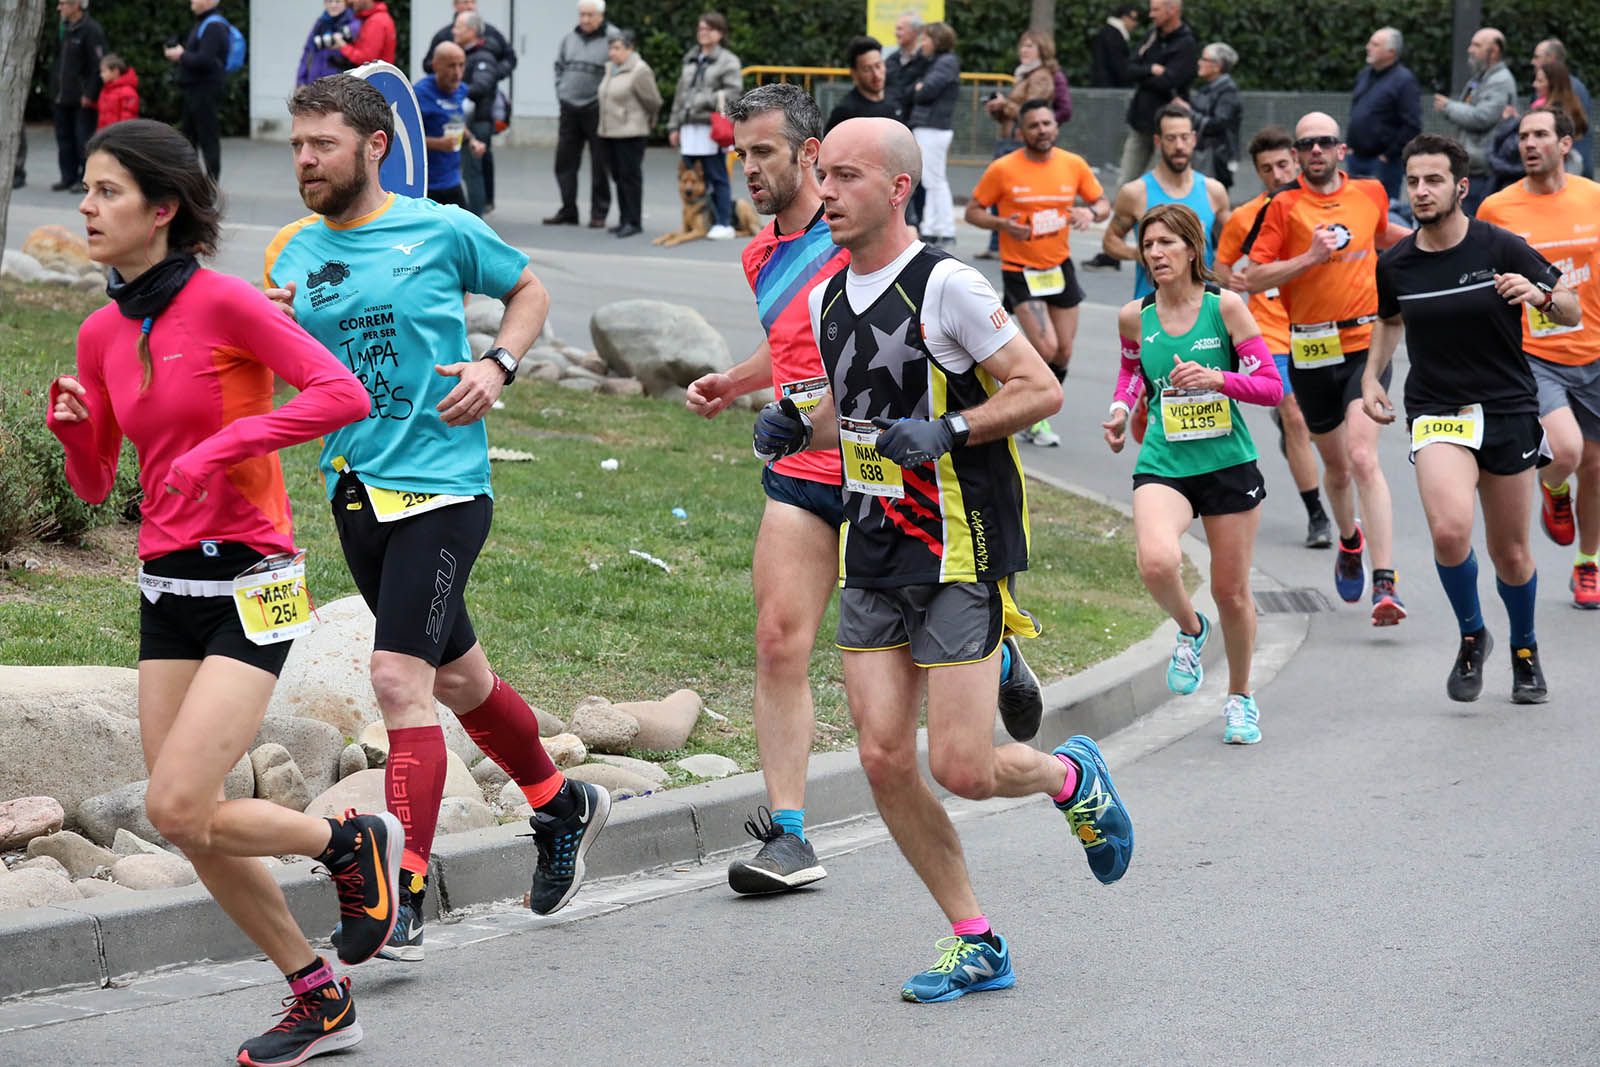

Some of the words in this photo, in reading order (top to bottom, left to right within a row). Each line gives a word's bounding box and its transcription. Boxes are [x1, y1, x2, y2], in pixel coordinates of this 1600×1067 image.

[339, 312, 395, 331] CORREM
[362, 330, 379, 341] PER
[380, 328, 397, 338] SER
[339, 337, 399, 374] IMPA
[1303, 343, 1329, 357] 991
[1170, 401, 1224, 418] VICTORIA
[1180, 415, 1217, 431] 1135
[1422, 422, 1465, 436] 1004
[859, 462, 884, 482] 638
[402, 491, 438, 508] 25
[425, 548, 457, 644] 2XU
[271, 604, 298, 626] 254
